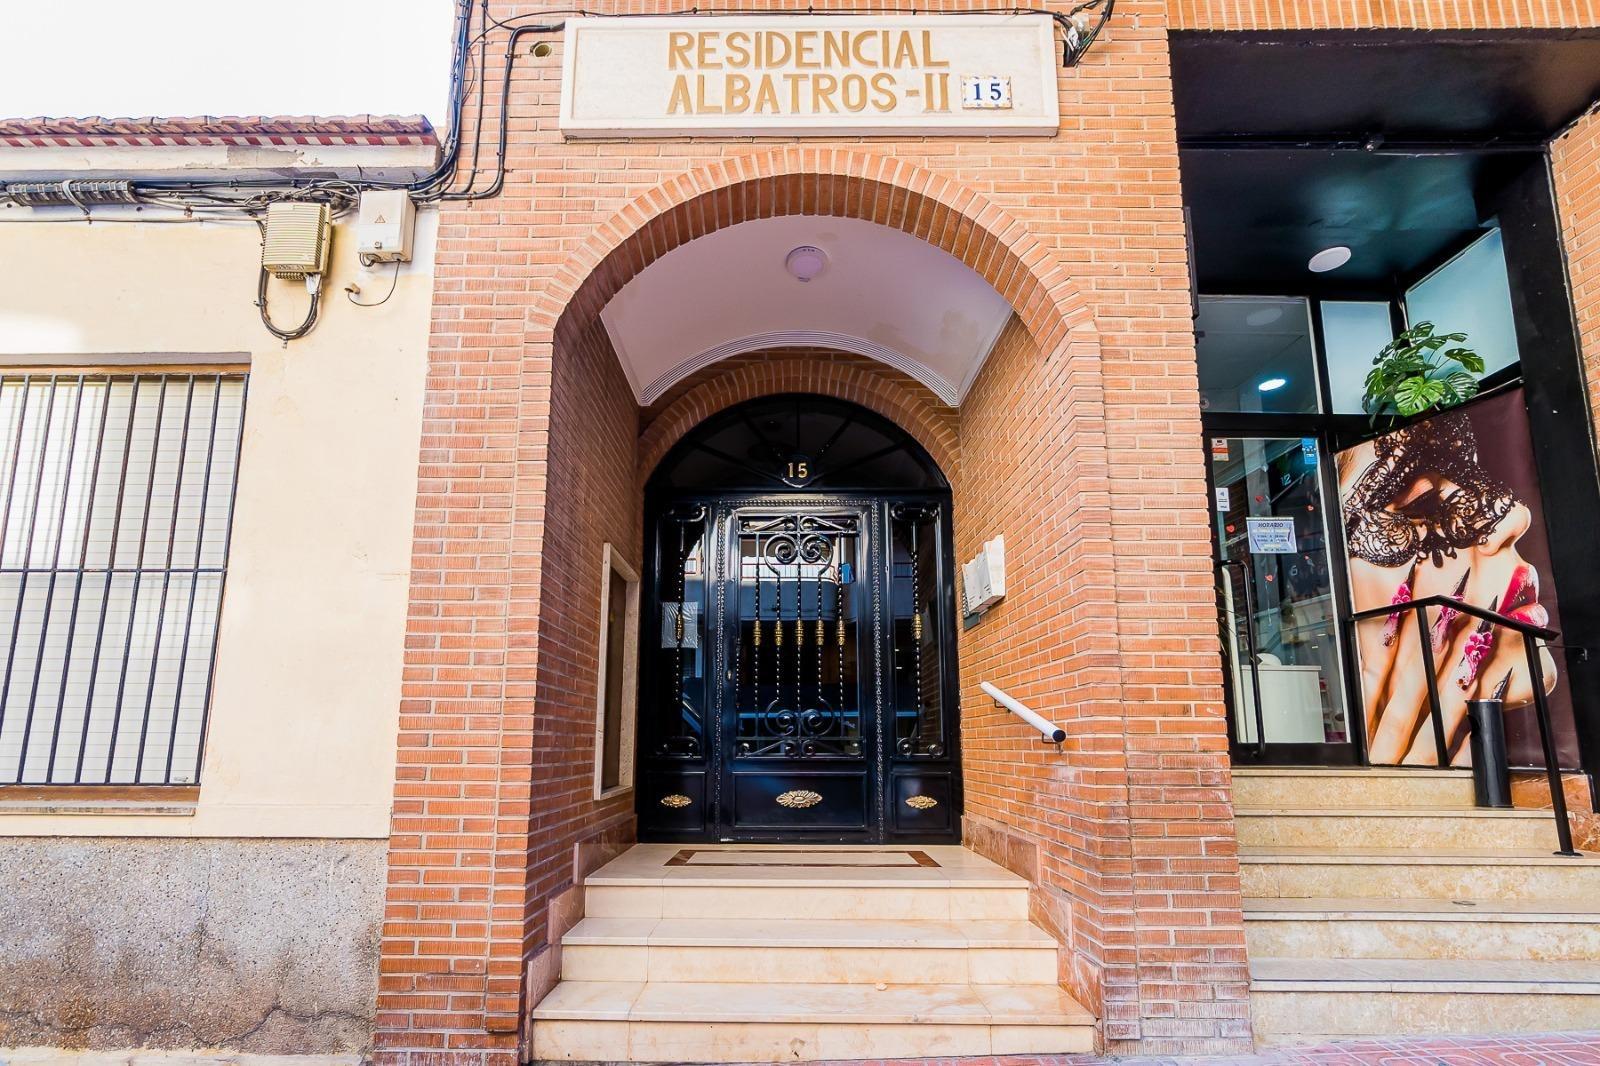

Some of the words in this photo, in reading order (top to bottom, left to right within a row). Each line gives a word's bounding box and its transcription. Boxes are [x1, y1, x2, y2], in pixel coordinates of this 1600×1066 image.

[668, 30, 949, 70] RESIDENCIAL
[972, 82, 1003, 102] 15
[788, 462, 808, 478] 15
